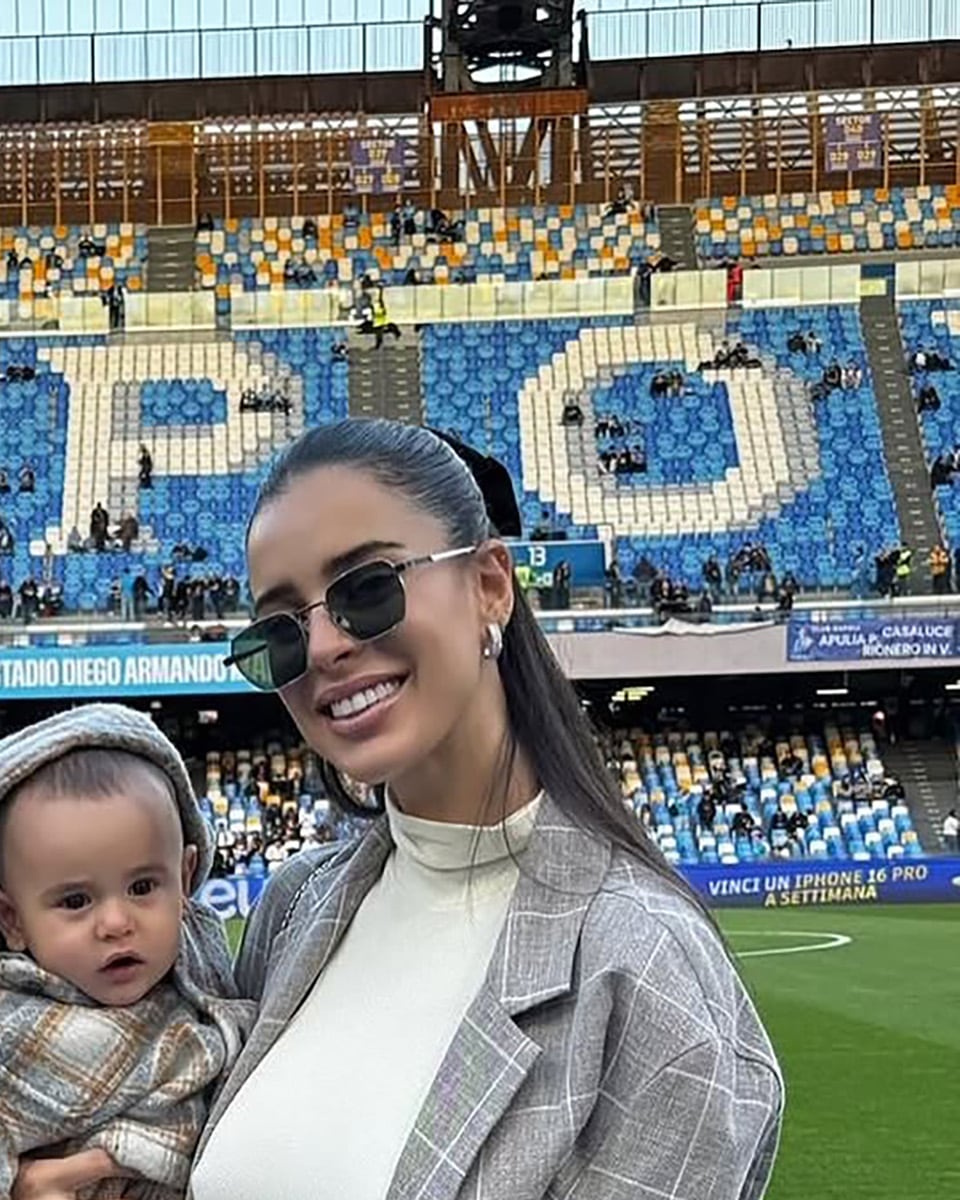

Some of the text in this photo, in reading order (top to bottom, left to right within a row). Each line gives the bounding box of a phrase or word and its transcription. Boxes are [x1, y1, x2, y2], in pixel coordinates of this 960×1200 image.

[528, 546, 547, 567] 13
[818, 633, 865, 646] APULIA
[881, 624, 954, 638] CASALUCE
[862, 643, 921, 656] RIONERO
[923, 643, 937, 655] IN
[62, 656, 121, 686] DIEGO
[124, 653, 228, 686] ARMANDO
[709, 864, 928, 895] VINCI UN IPHONE 16 PRO
[764, 884, 877, 907] A SETTIMANA
